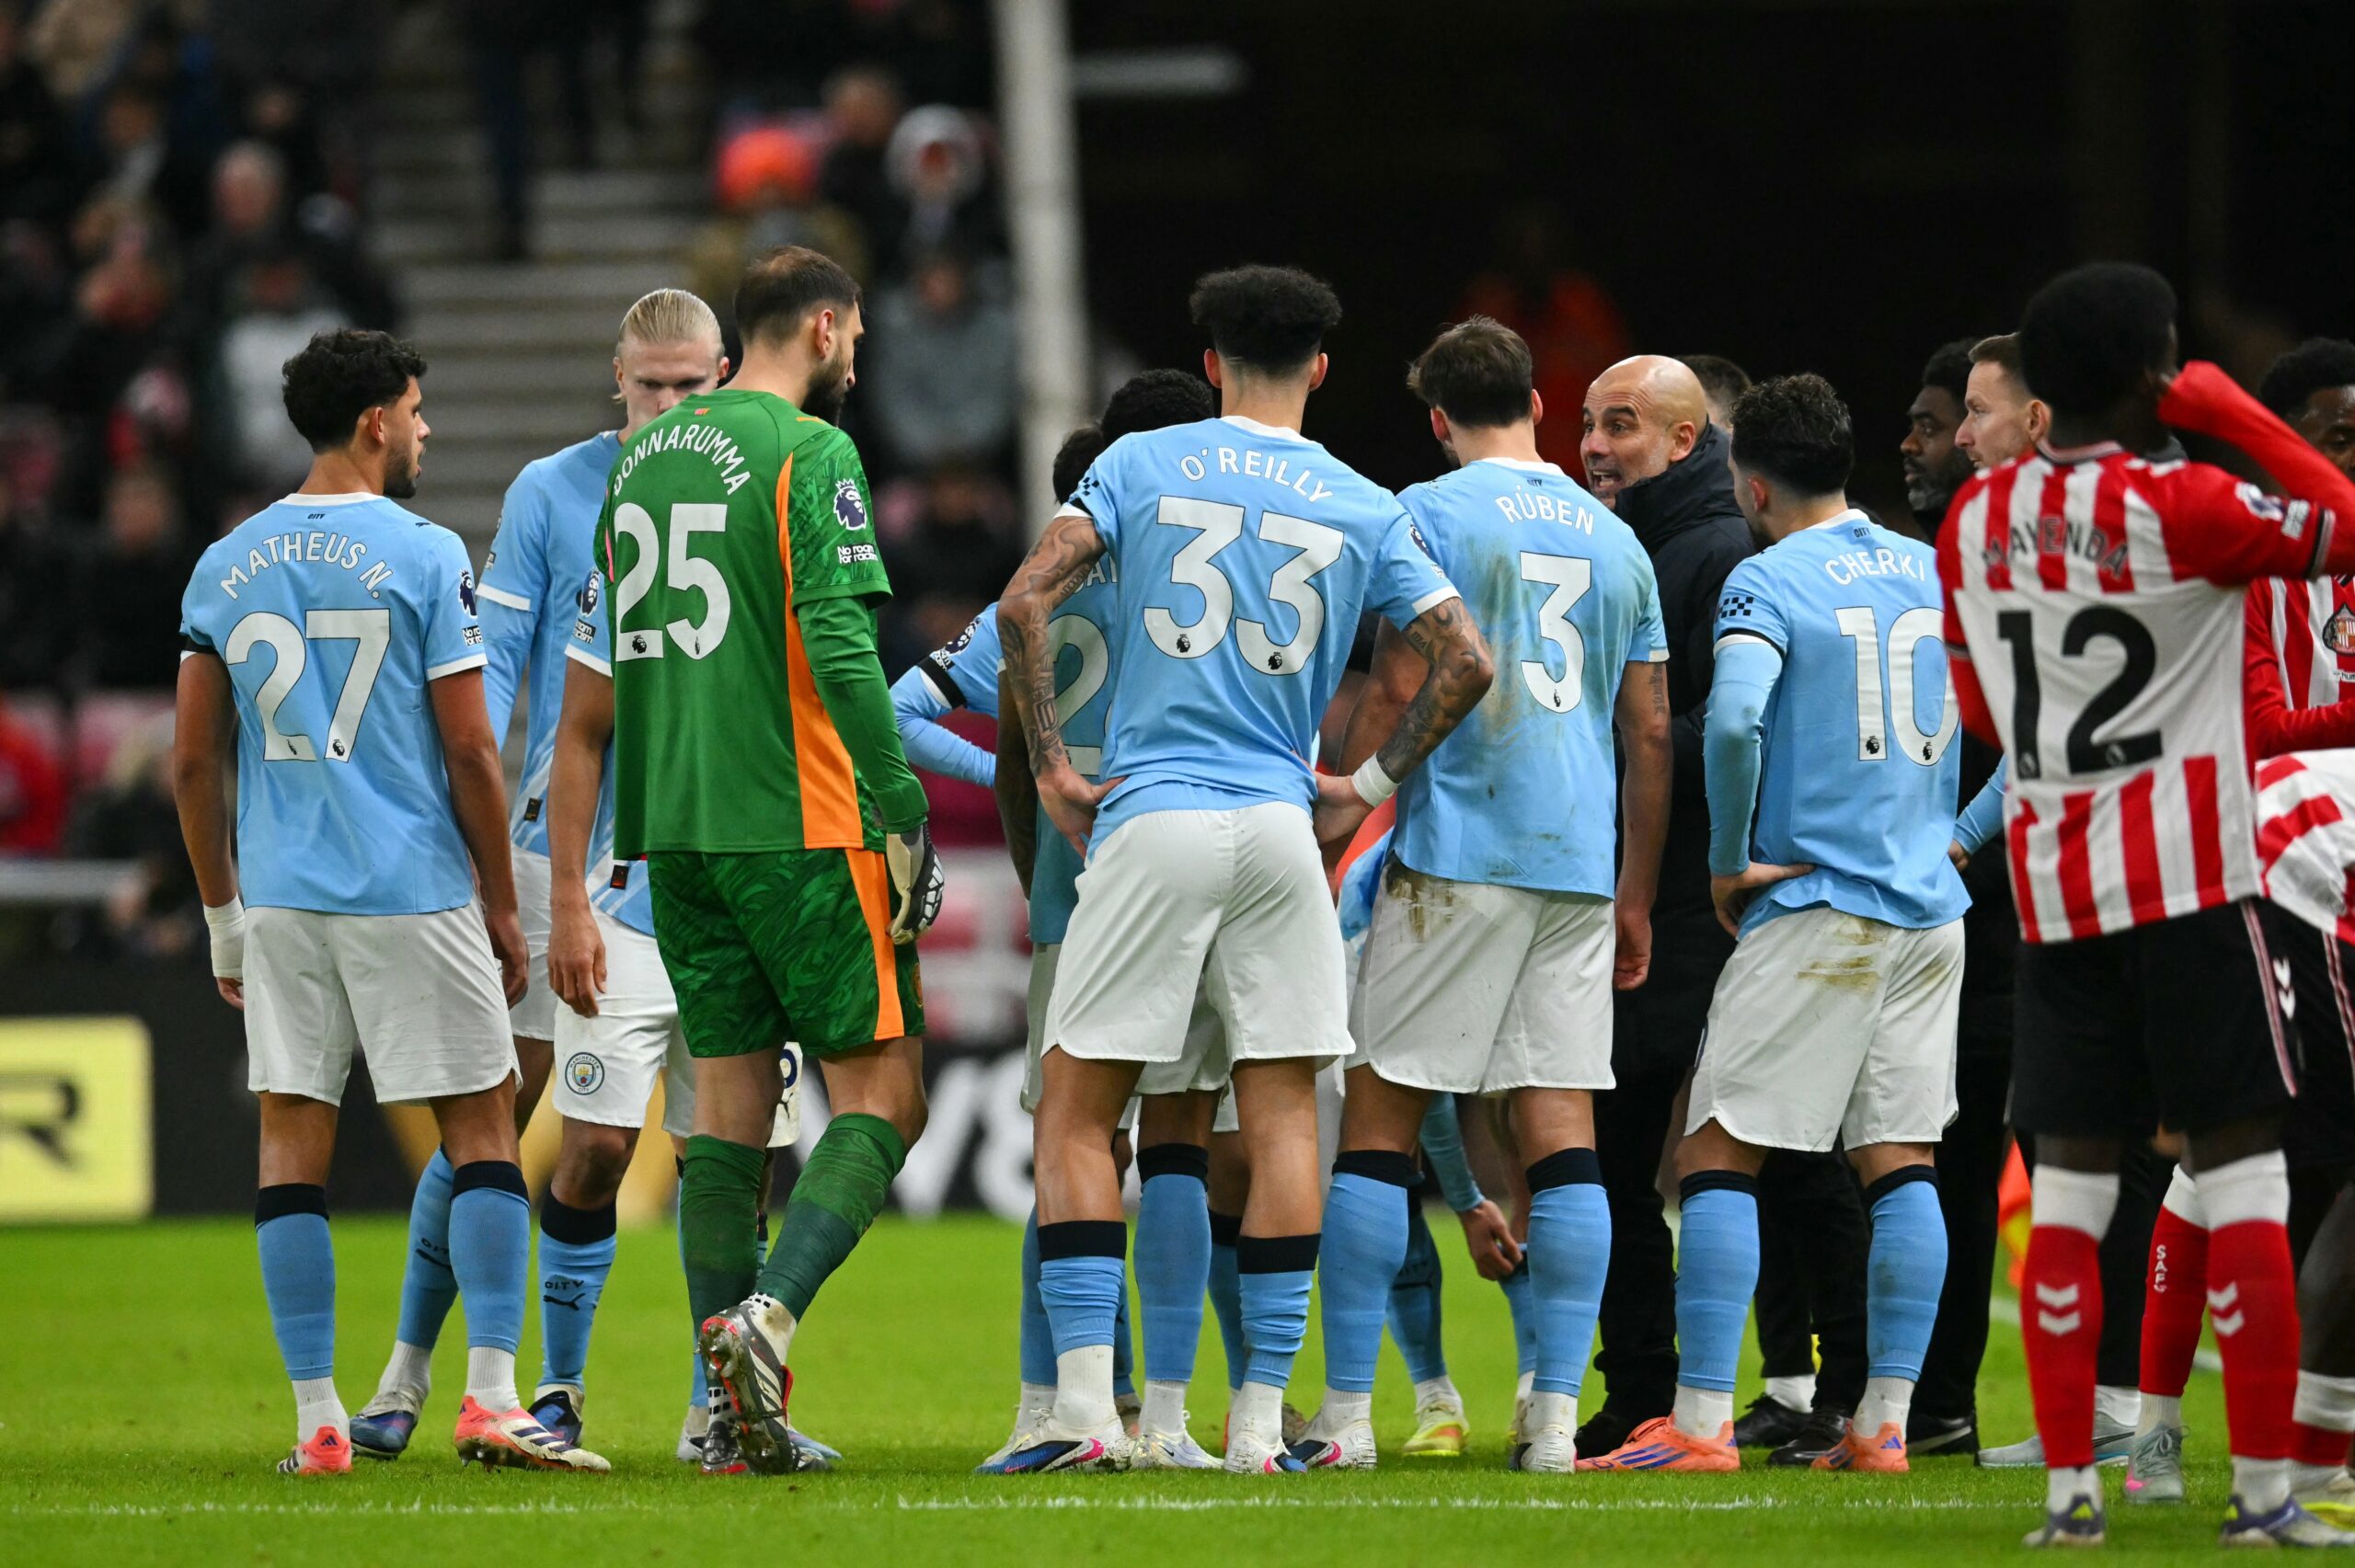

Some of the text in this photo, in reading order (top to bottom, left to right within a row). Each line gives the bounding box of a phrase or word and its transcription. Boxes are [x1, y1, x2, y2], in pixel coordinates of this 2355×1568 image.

[614, 423, 751, 498] DONNARUMMA
[1179, 446, 1333, 504] O'REILLY
[1494, 484, 1595, 537] RÚBEN
[1853, 527, 1871, 538] CITY
[220, 531, 394, 601] MATHEUS N.
[614, 502, 731, 662] 25
[837, 545, 852, 555] No
[1824, 547, 1926, 587] CHERKI
[1982, 515, 2130, 580] MAYENDA
[1143, 494, 1345, 676] 33
[1519, 550, 1592, 714] 3
[224, 607, 391, 763] 27
[1833, 605, 1961, 767] 10
[1996, 603, 2163, 780] 12
